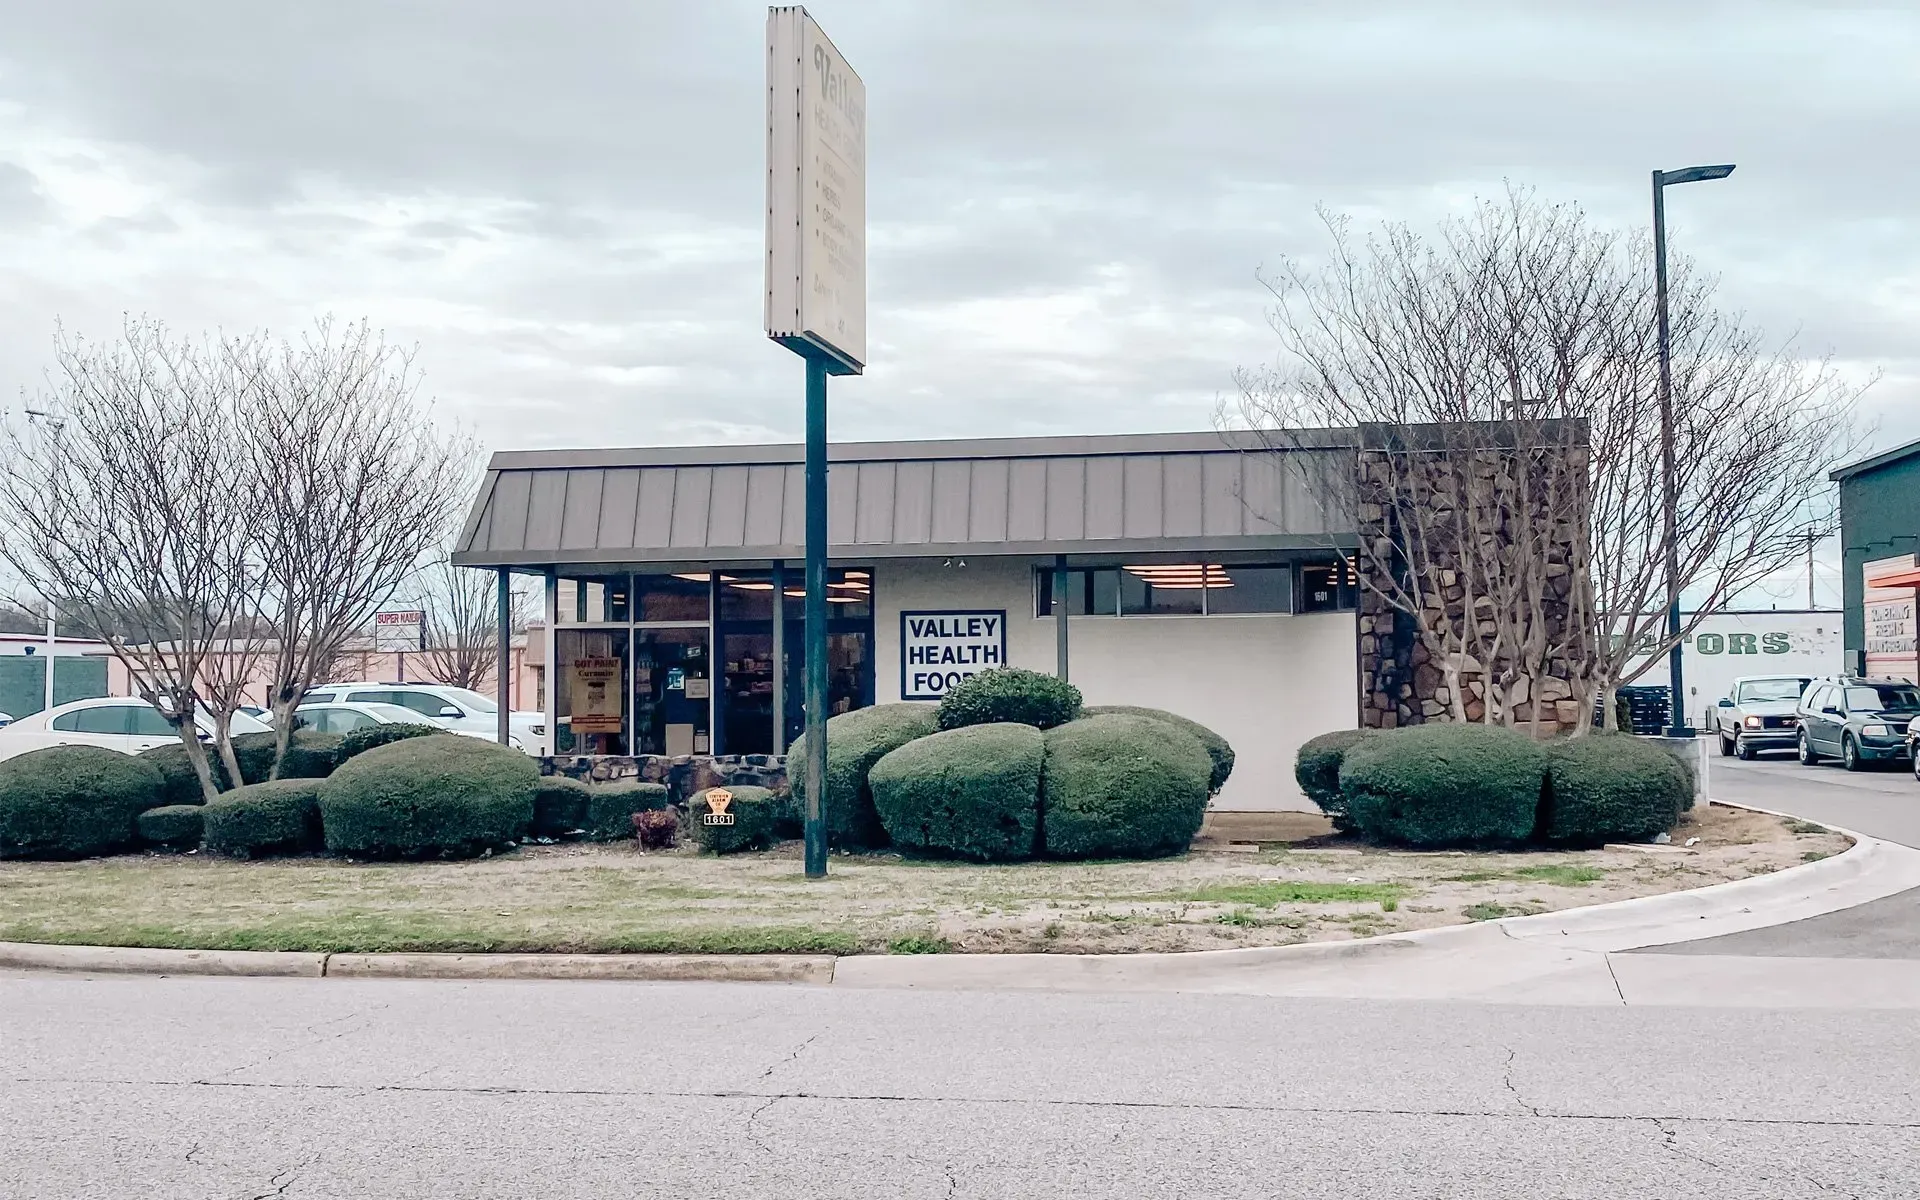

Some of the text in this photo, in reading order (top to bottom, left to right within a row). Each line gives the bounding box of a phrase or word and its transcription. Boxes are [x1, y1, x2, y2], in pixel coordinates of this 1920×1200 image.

[814, 43, 865, 141] Valley
[378, 614, 398, 623] SUPER
[909, 618, 997, 637] VALLEY
[574, 660, 591, 668] GOT
[909, 645, 998, 664] HEALTH
[914, 671, 975, 691] FOO
[707, 815, 731, 824] 1601
